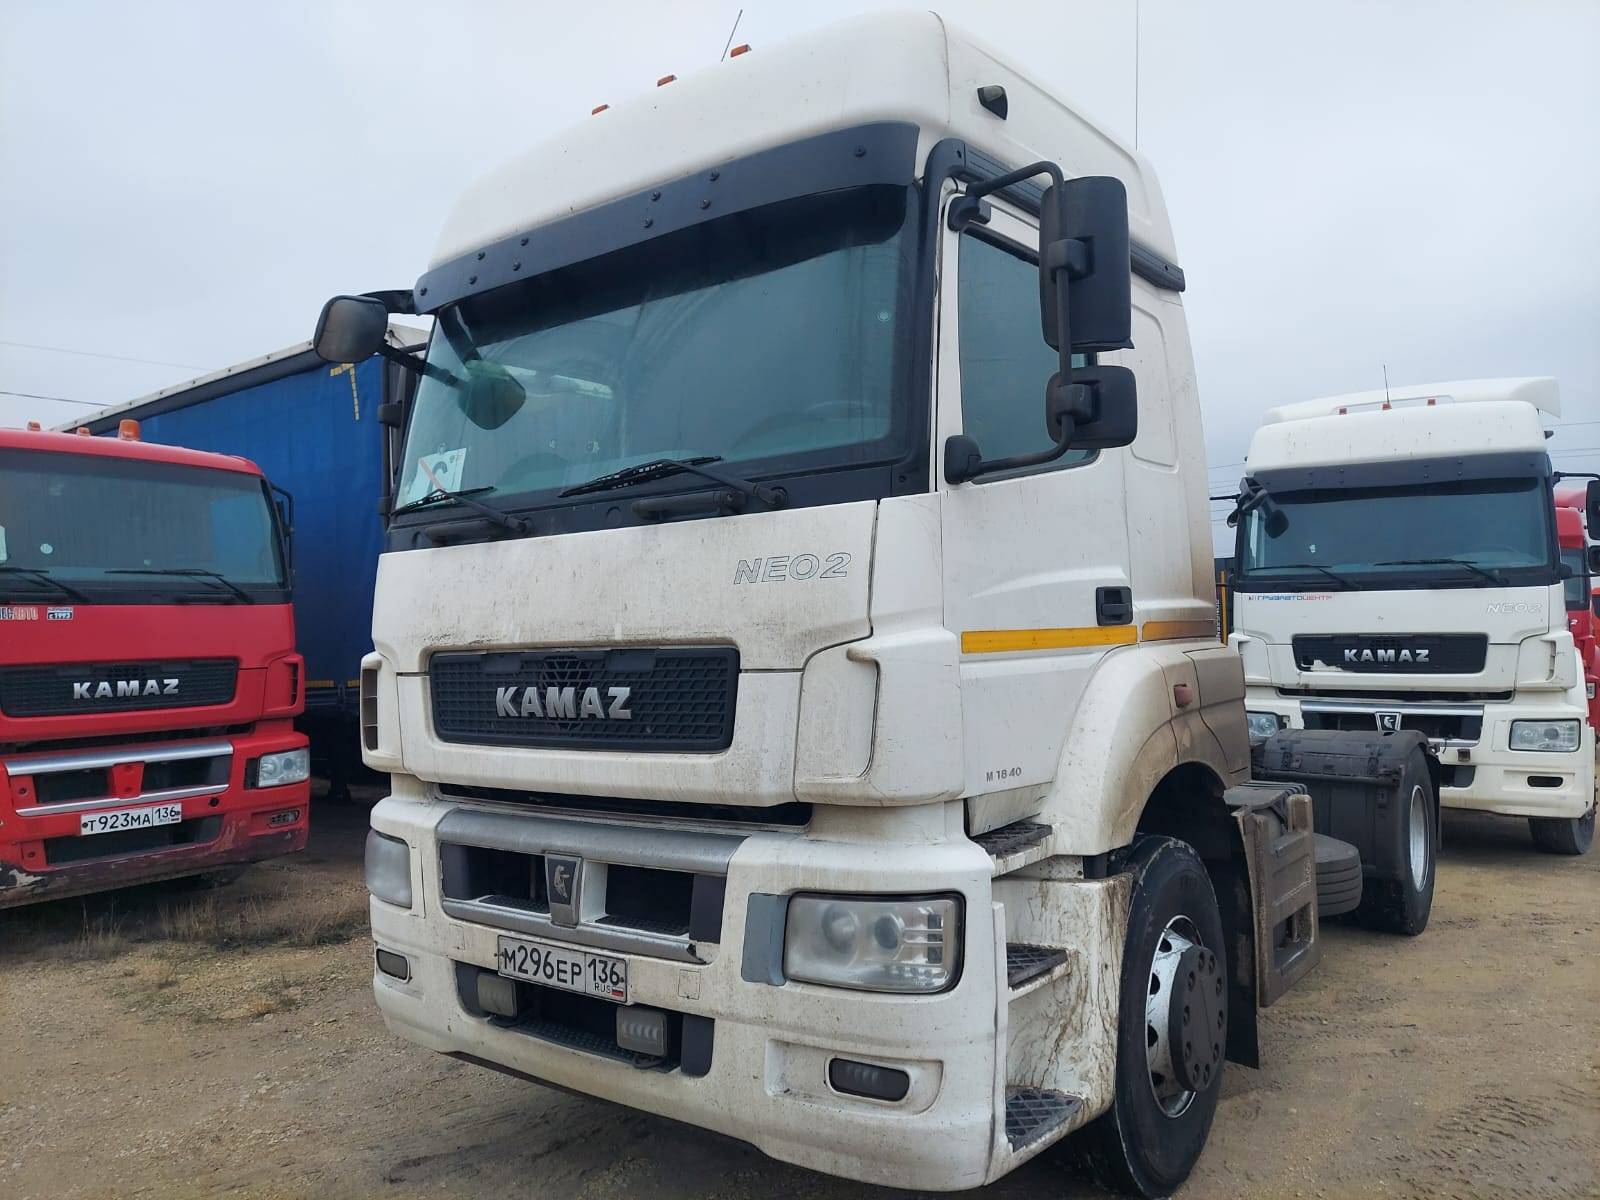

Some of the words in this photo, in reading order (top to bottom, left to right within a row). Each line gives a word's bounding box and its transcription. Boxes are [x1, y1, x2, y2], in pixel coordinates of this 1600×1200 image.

[733, 551, 852, 585] NEO2
[1344, 648, 1431, 663] KAMAZ
[72, 678, 180, 700] KAMAZ
[495, 686, 633, 721] KAMAZ
[155, 806, 177, 819] 136
[587, 958, 620, 986] 136
[594, 982, 611, 994] RUS
